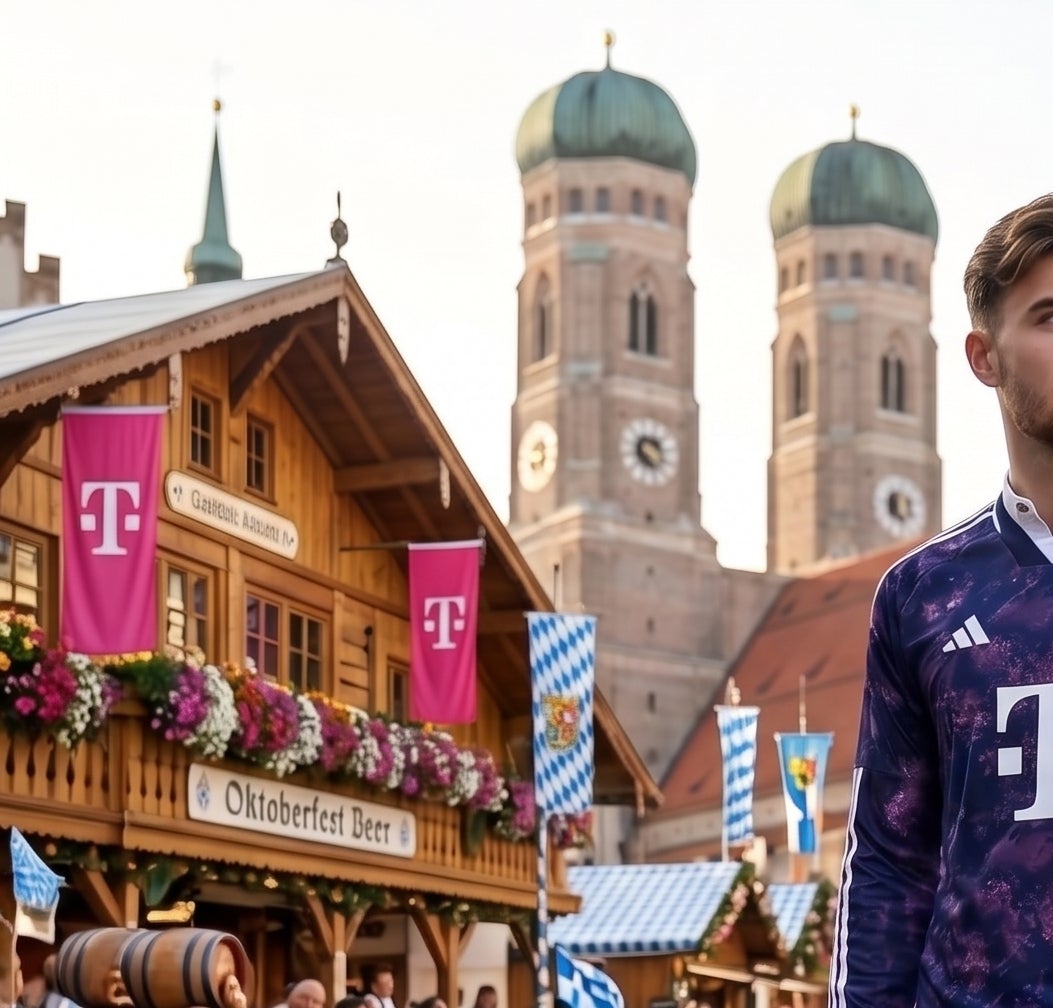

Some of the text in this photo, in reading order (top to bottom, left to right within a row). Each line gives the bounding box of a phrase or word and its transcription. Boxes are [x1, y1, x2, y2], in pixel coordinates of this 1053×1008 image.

[80, 481, 140, 556] T
[423, 595, 466, 650] T
[225, 779, 344, 837] Oktoberfest
